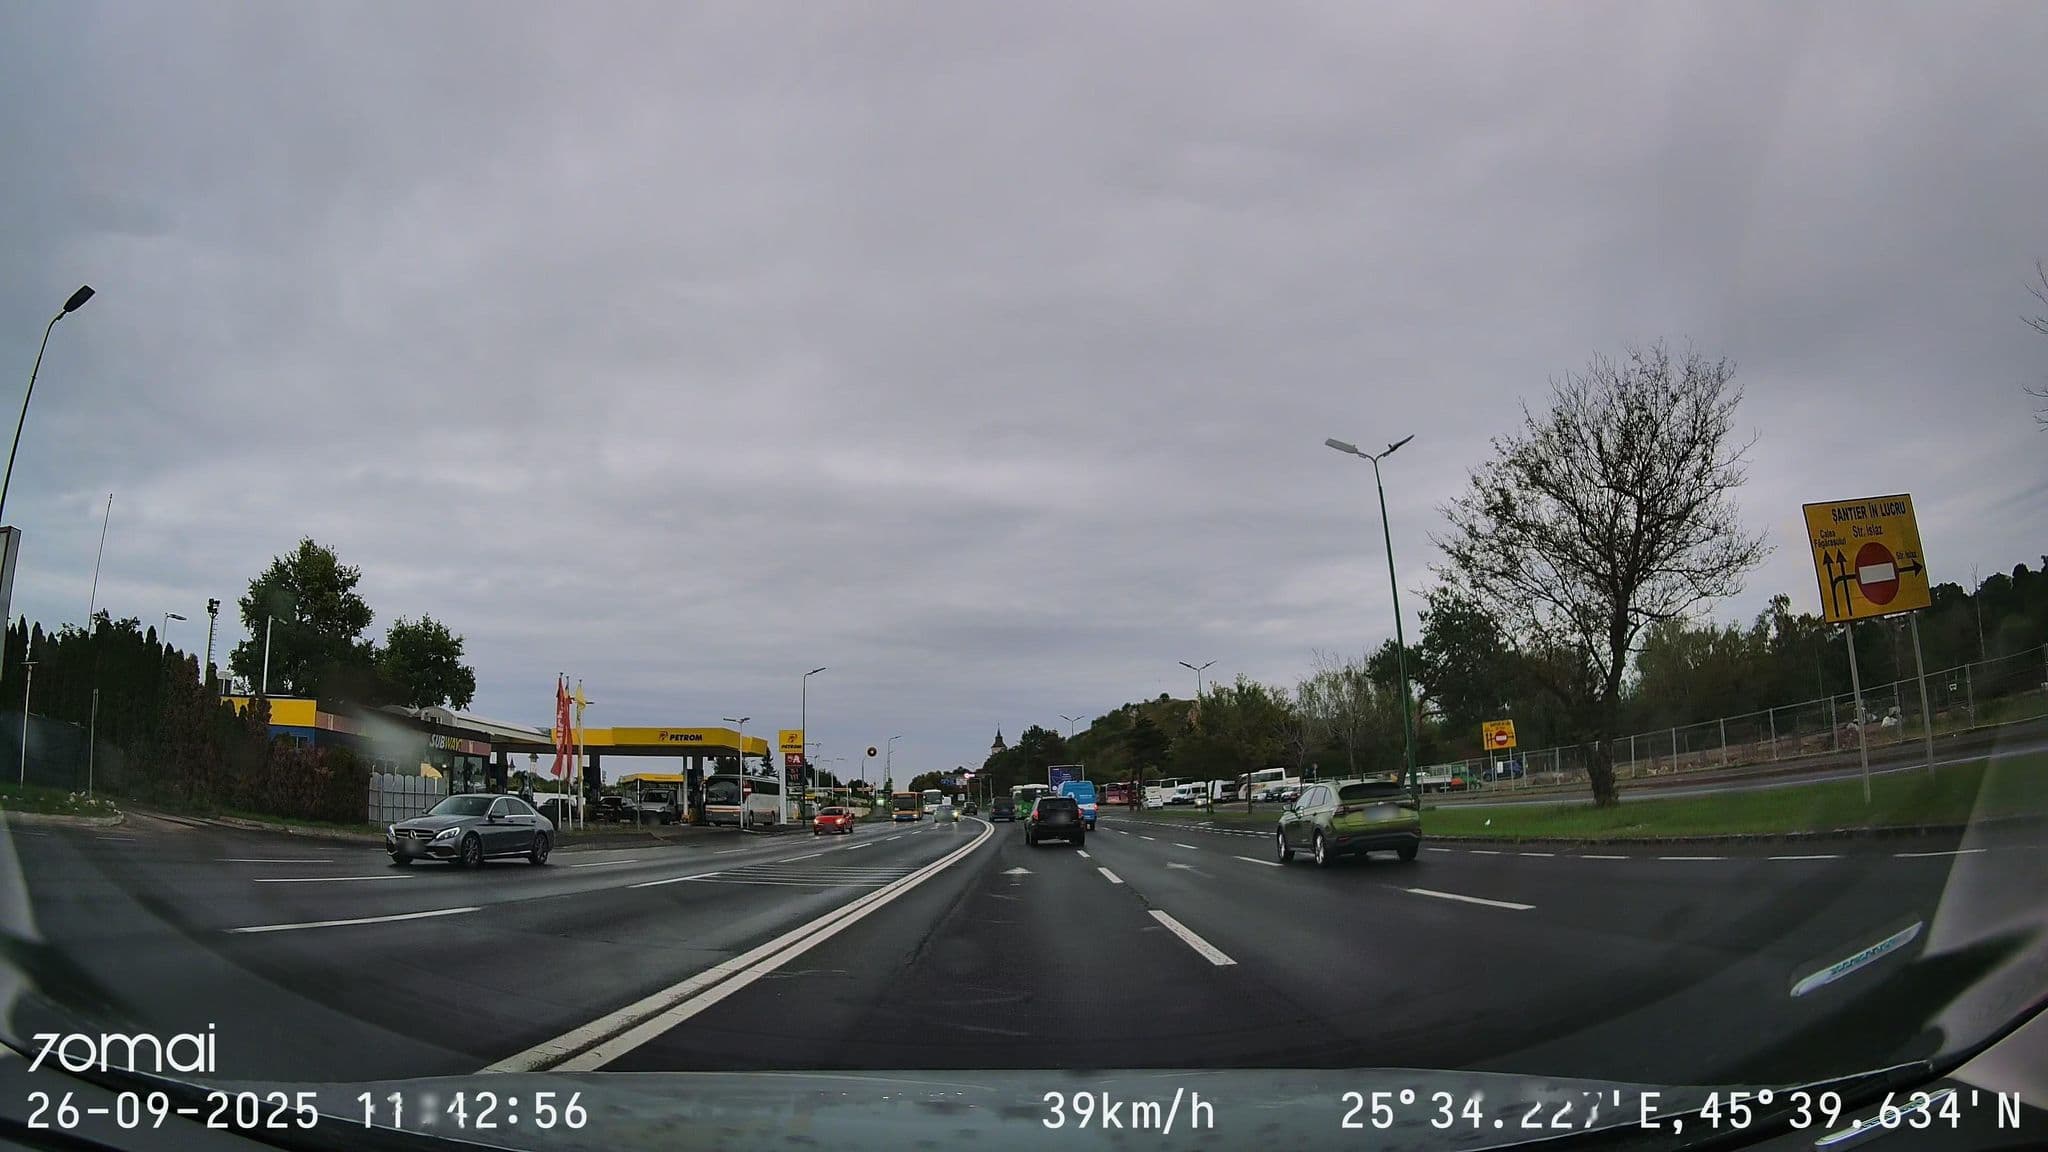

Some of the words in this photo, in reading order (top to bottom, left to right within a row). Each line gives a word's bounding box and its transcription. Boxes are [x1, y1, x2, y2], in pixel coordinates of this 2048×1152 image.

[1880, 501, 1906, 517] LUCRU
[1852, 525, 1865, 538] Str.
[429, 734, 462, 751] SUBWAY
[669, 734, 703, 742] PETROM
